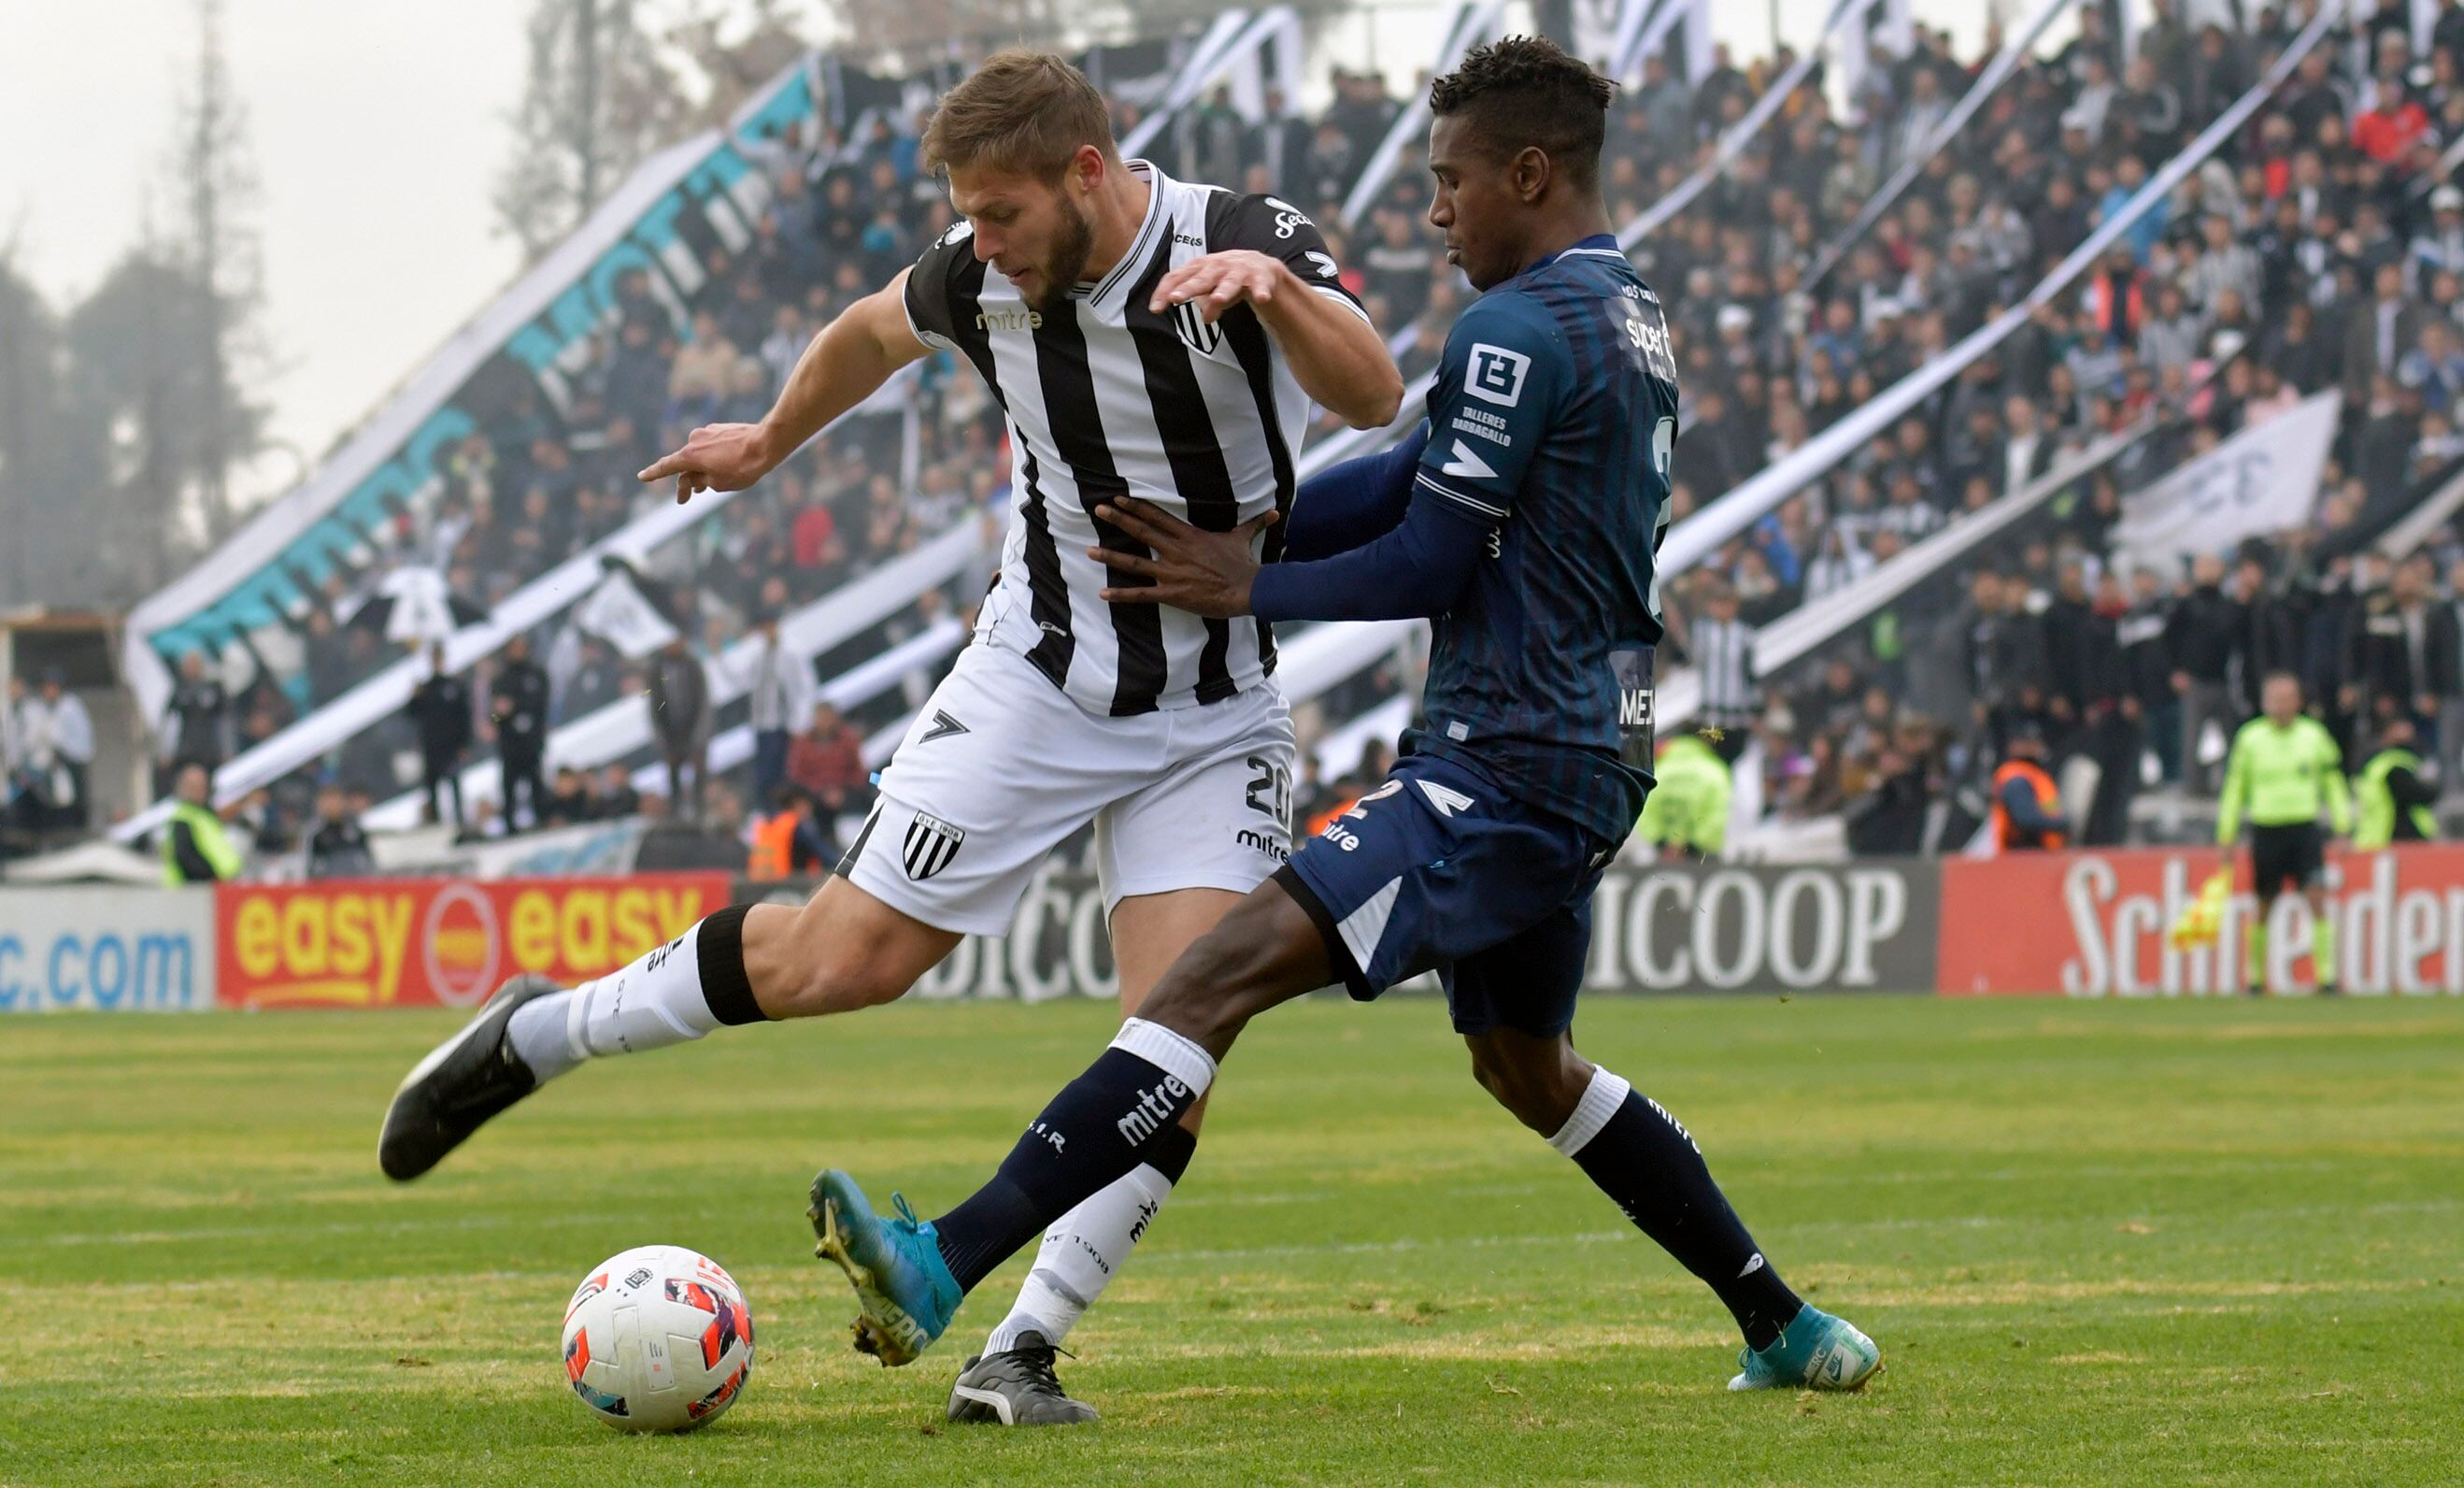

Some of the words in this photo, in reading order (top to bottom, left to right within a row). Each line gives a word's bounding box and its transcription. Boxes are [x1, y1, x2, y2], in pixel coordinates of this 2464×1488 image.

[976, 308, 1043, 330] mitre
[1451, 417, 1513, 448] BARBAGALLO
[1462, 406, 1507, 430] TALLERES
[1246, 755, 1291, 831] 20
[1344, 778, 1404, 820] 2
[1236, 829, 1291, 866] mitre
[235, 893, 415, 1003] easy
[509, 889, 703, 971] easy
[1118, 1074, 1188, 1148] mitre
[1074, 1235, 1110, 1275] 1908
